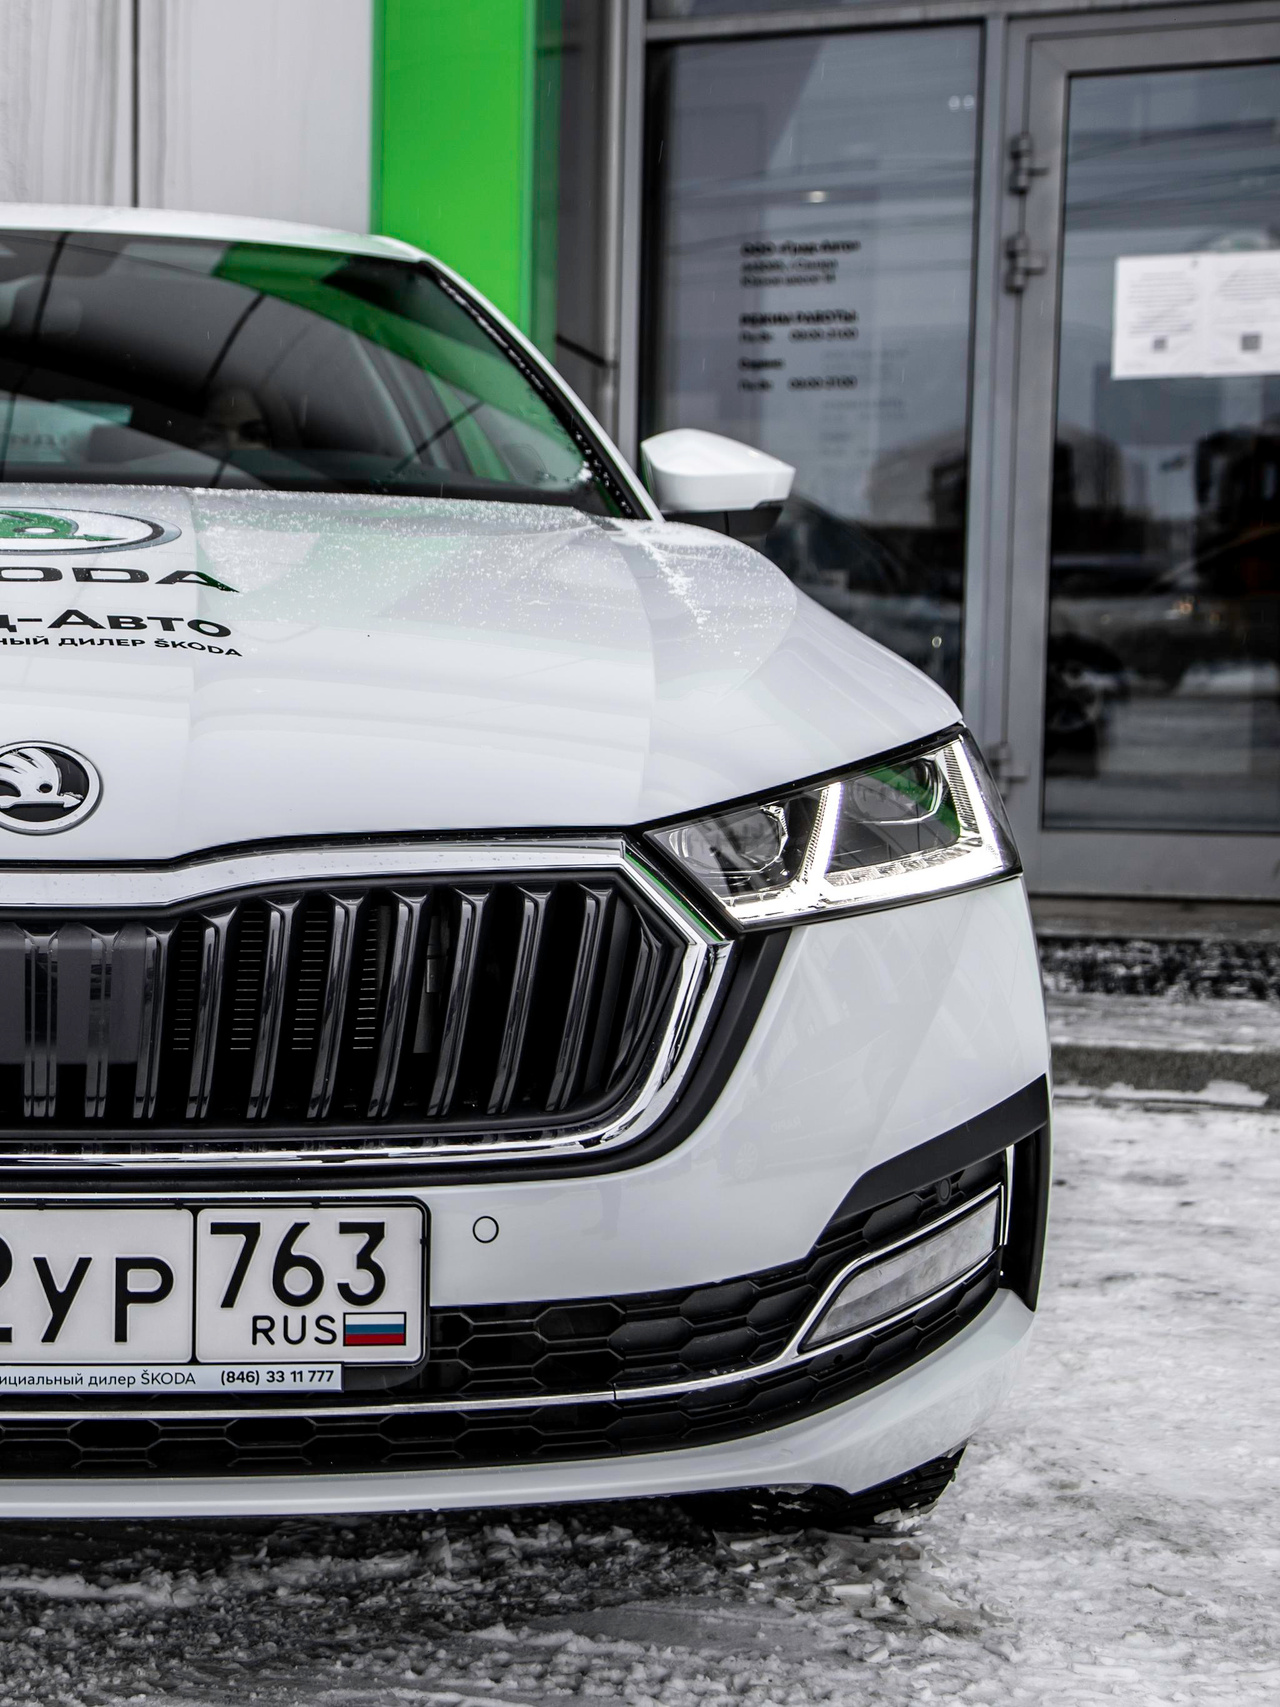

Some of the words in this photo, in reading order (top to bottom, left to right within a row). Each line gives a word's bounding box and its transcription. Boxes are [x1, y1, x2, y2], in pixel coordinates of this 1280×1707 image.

[58, 636, 146, 648] ДИЛЕР
[154, 638, 243, 657] ŠKODA
[210, 1221, 386, 1308] 763
[251, 1314, 337, 1346] RUS
[87, 1375, 136, 1388] дилер
[140, 1369, 197, 1386] ŠKODA
[220, 1369, 261, 1386] (846)
[266, 1369, 285, 1384] 33
[290, 1369, 303, 1383] 11
[307, 1369, 335, 1384] 777
